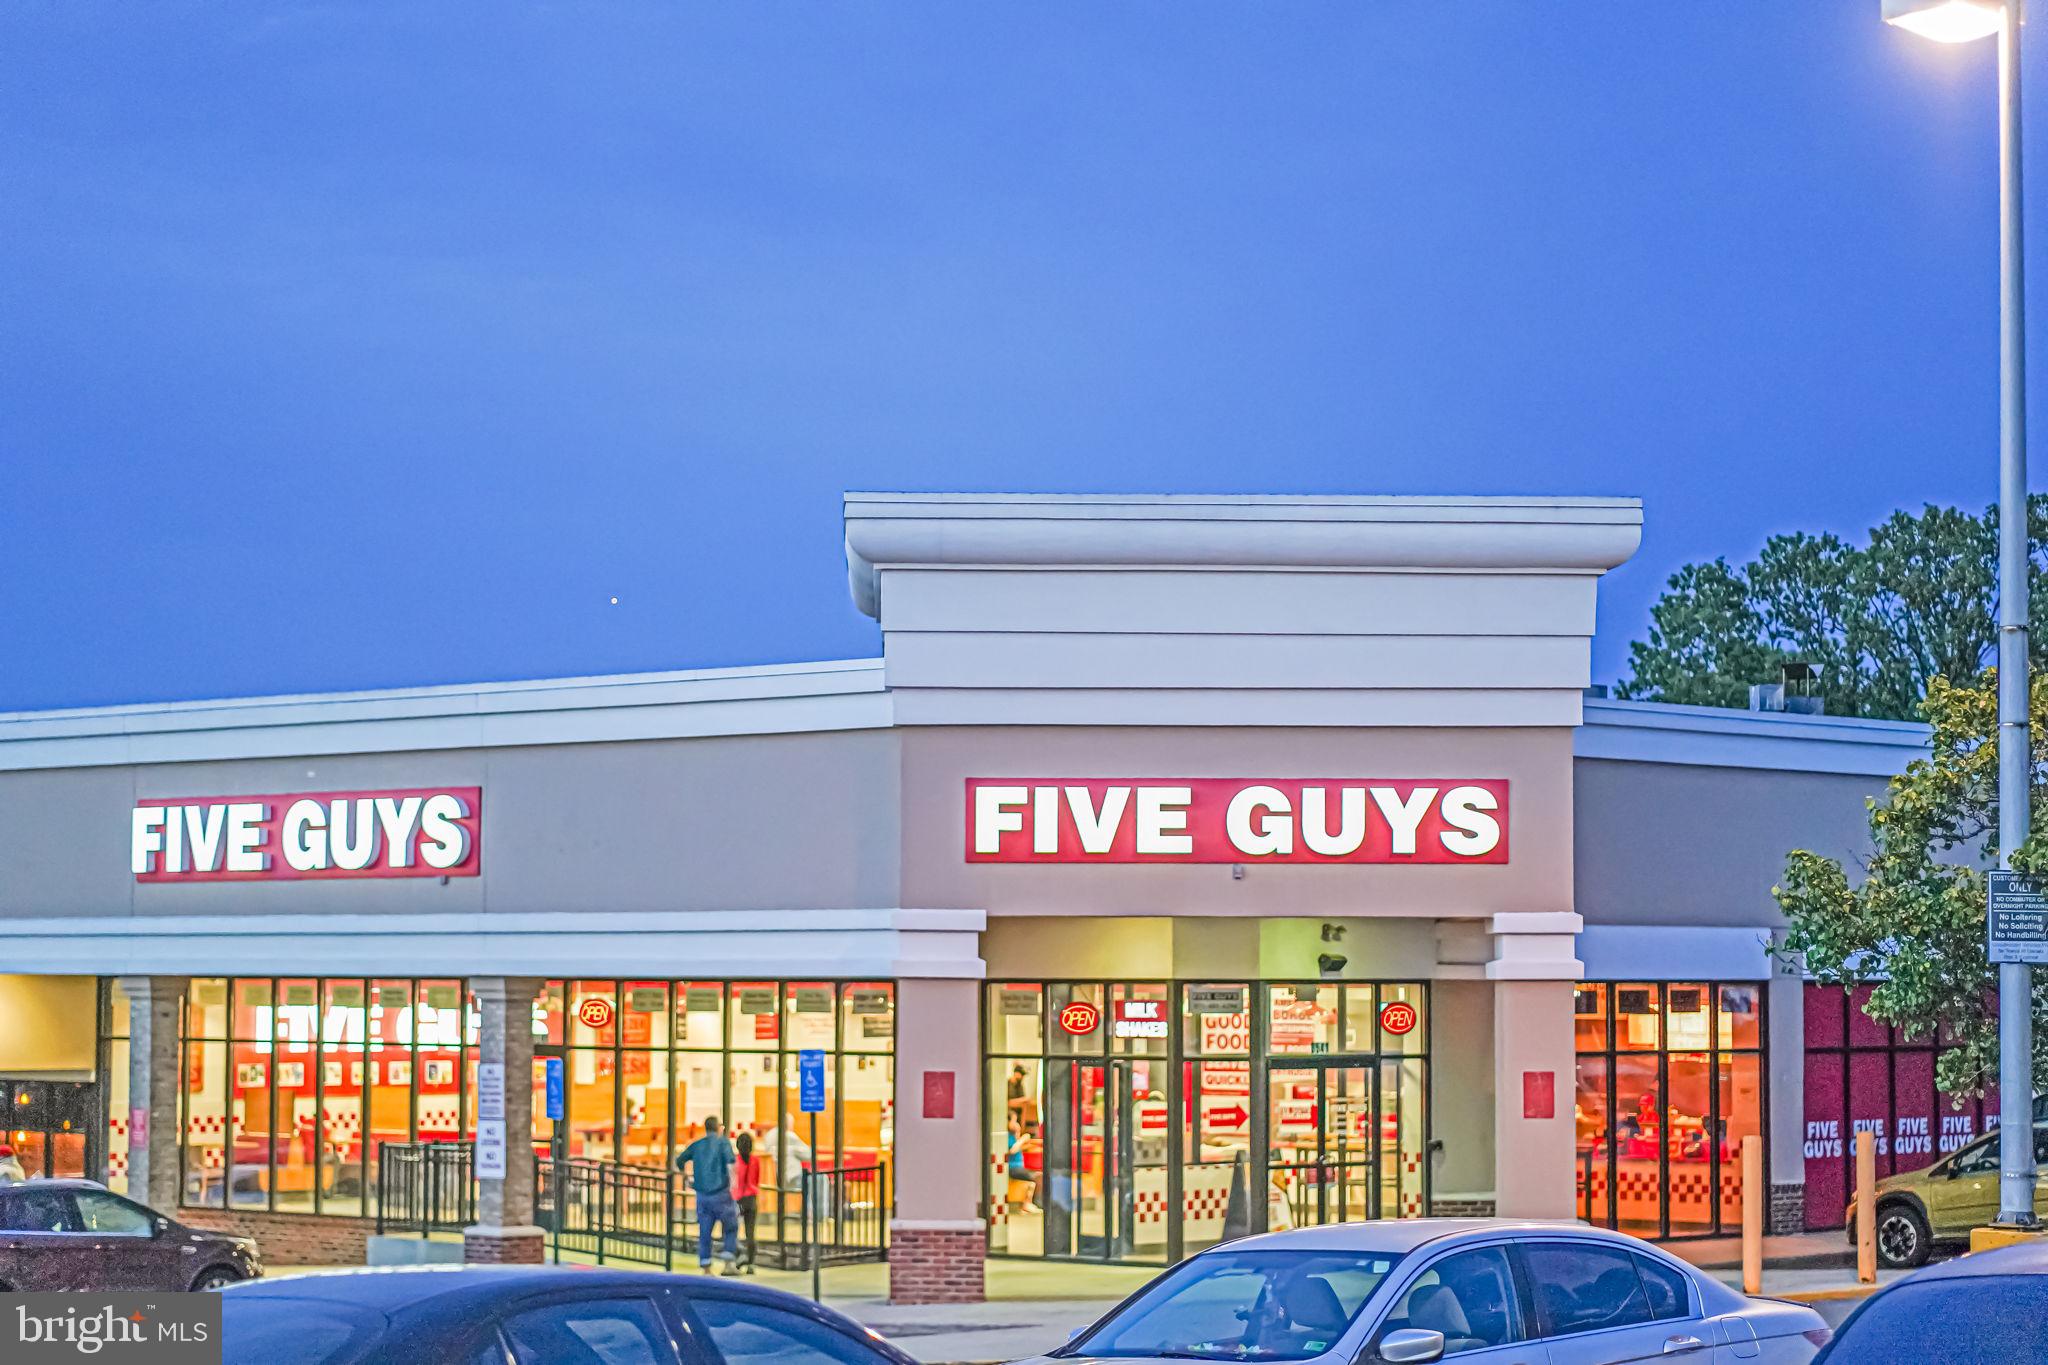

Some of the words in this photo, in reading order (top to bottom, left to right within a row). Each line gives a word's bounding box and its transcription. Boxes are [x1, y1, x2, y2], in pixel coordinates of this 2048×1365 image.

[975, 786, 1193, 853] FIVE
[1226, 785, 1500, 855] GUYS
[132, 803, 269, 873] FIVE
[282, 794, 468, 870] GUYS
[2009, 882, 2032, 893] ONLY
[2011, 914, 2043, 922] Loitering
[2011, 922, 2043, 931] Soliciting
[581, 1005, 610, 1021] OPEN
[1062, 1010, 1095, 1027] OPEN
[1384, 1009, 1413, 1026] OPEN
[1807, 1121, 1839, 1139] FIVE
[1853, 1119, 1884, 1136] FIVE
[1898, 1117, 1929, 1135] FIVE
[1942, 1116, 1972, 1133] FIVE
[1804, 1139, 1843, 1158] GUYS
[1895, 1135, 1932, 1154] GUYS
